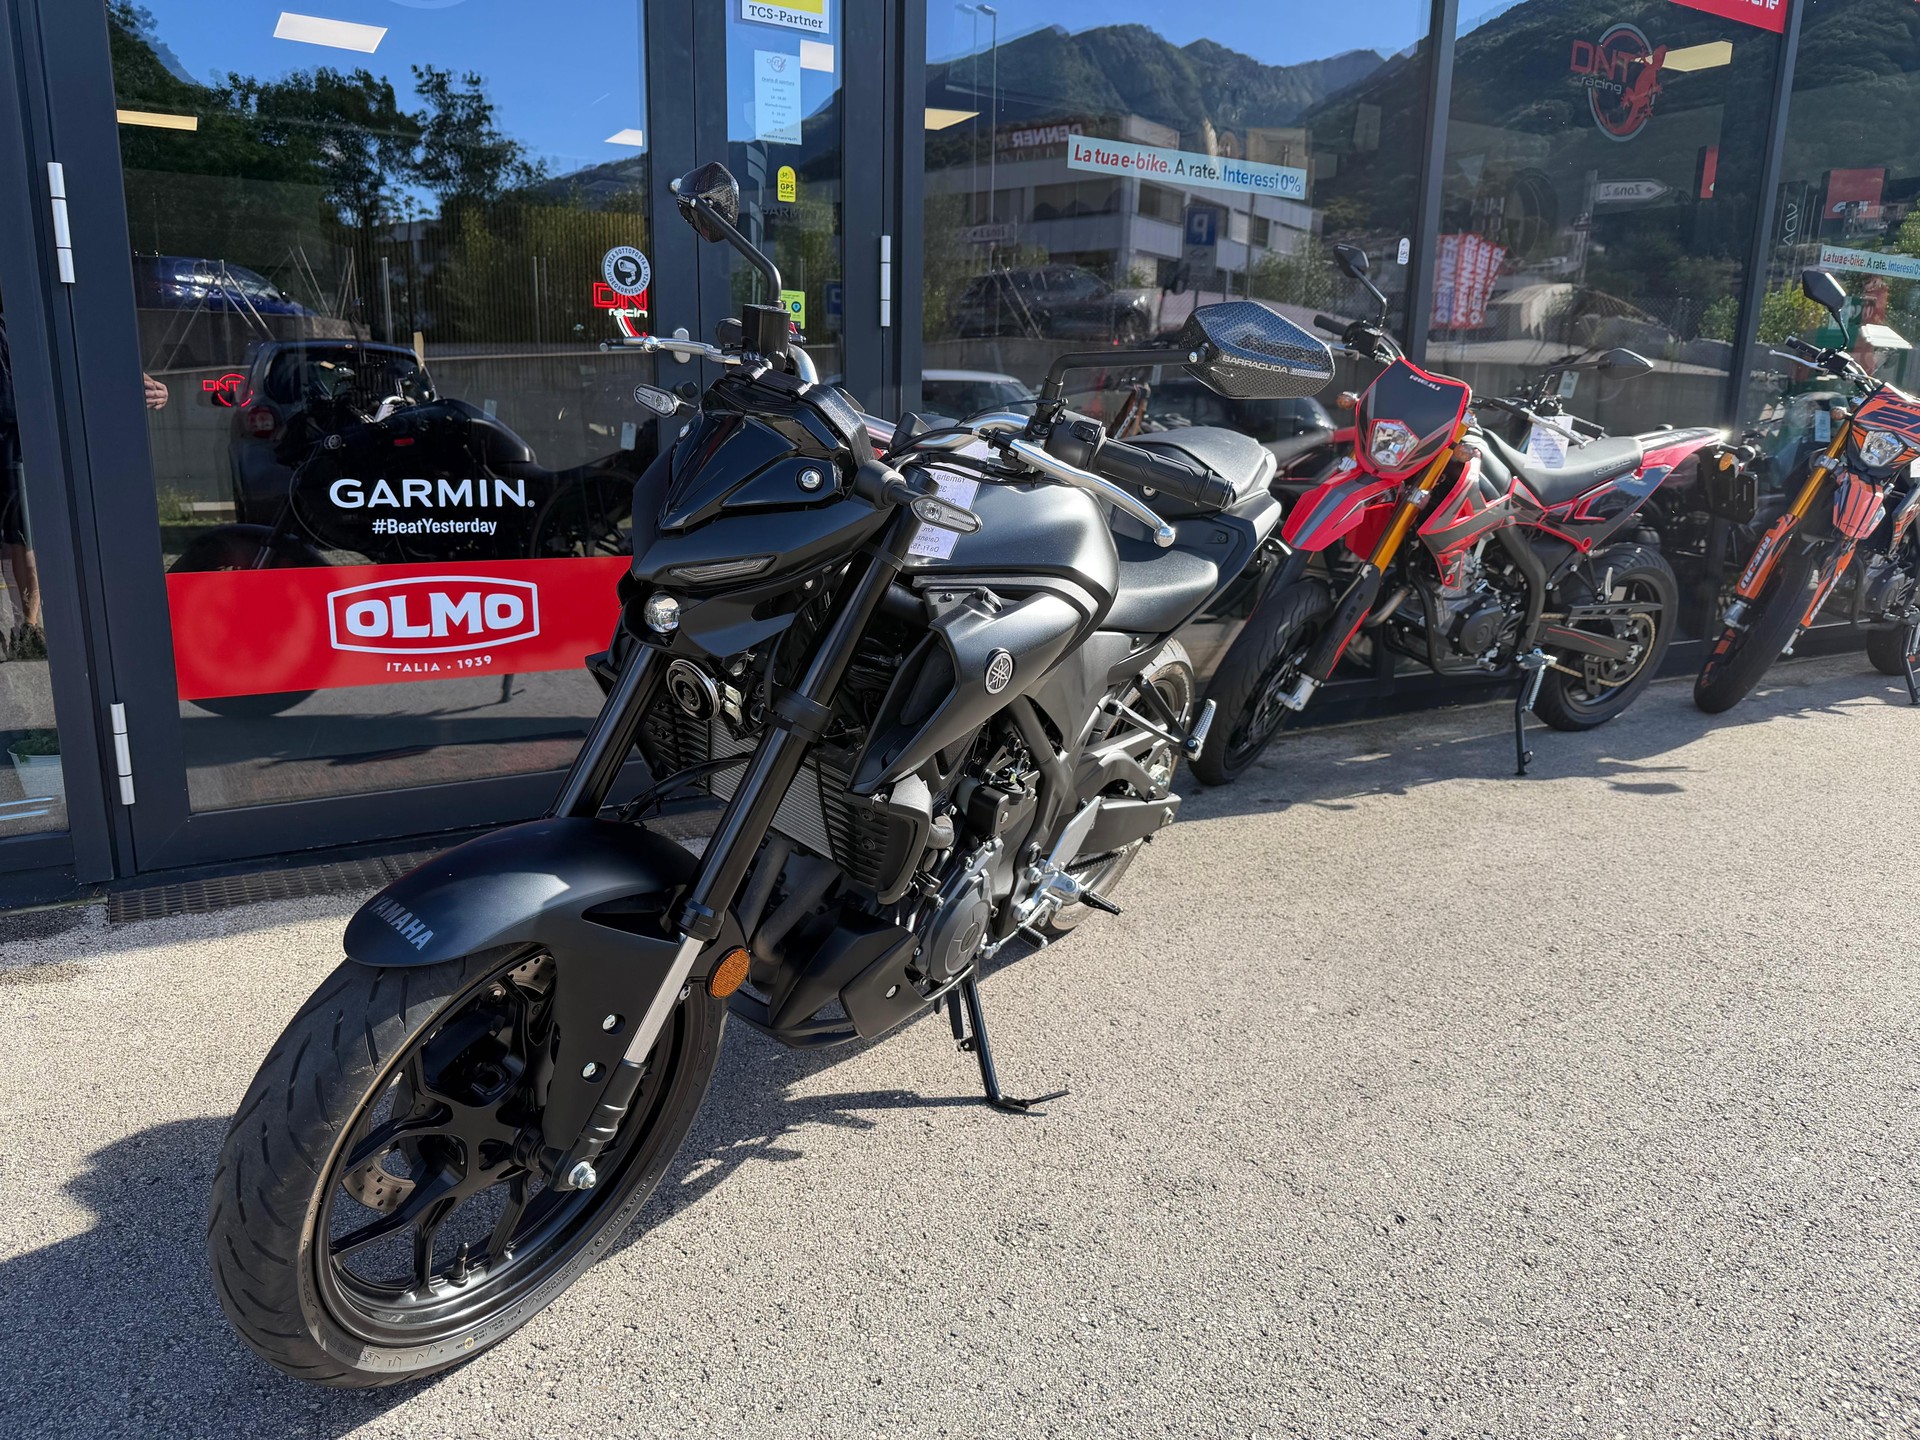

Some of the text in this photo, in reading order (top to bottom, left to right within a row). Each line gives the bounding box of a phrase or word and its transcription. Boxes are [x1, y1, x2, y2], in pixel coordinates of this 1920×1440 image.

[748, 4, 824, 28] TCS-Partner
[1570, 39, 1635, 83] DNT
[1581, 76, 1622, 95] racing
[1074, 143, 1301, 193] La tua e-bike. A rate. Interessi 0%
[780, 182, 794, 191] GPS
[1823, 250, 1831, 262] La
[1866, 257, 1872, 268] A
[1872, 259, 1887, 270] rate.
[1888, 260, 1914, 274] Interessi
[1222, 354, 1288, 373] BARRACUDA
[202, 379, 241, 392] DNT
[372, 517, 497, 536] #BeatYesterday
[346, 592, 524, 639] OLMO
[386, 654, 492, 674] ITALIA 1939
[368, 894, 434, 950] YAMAHA
